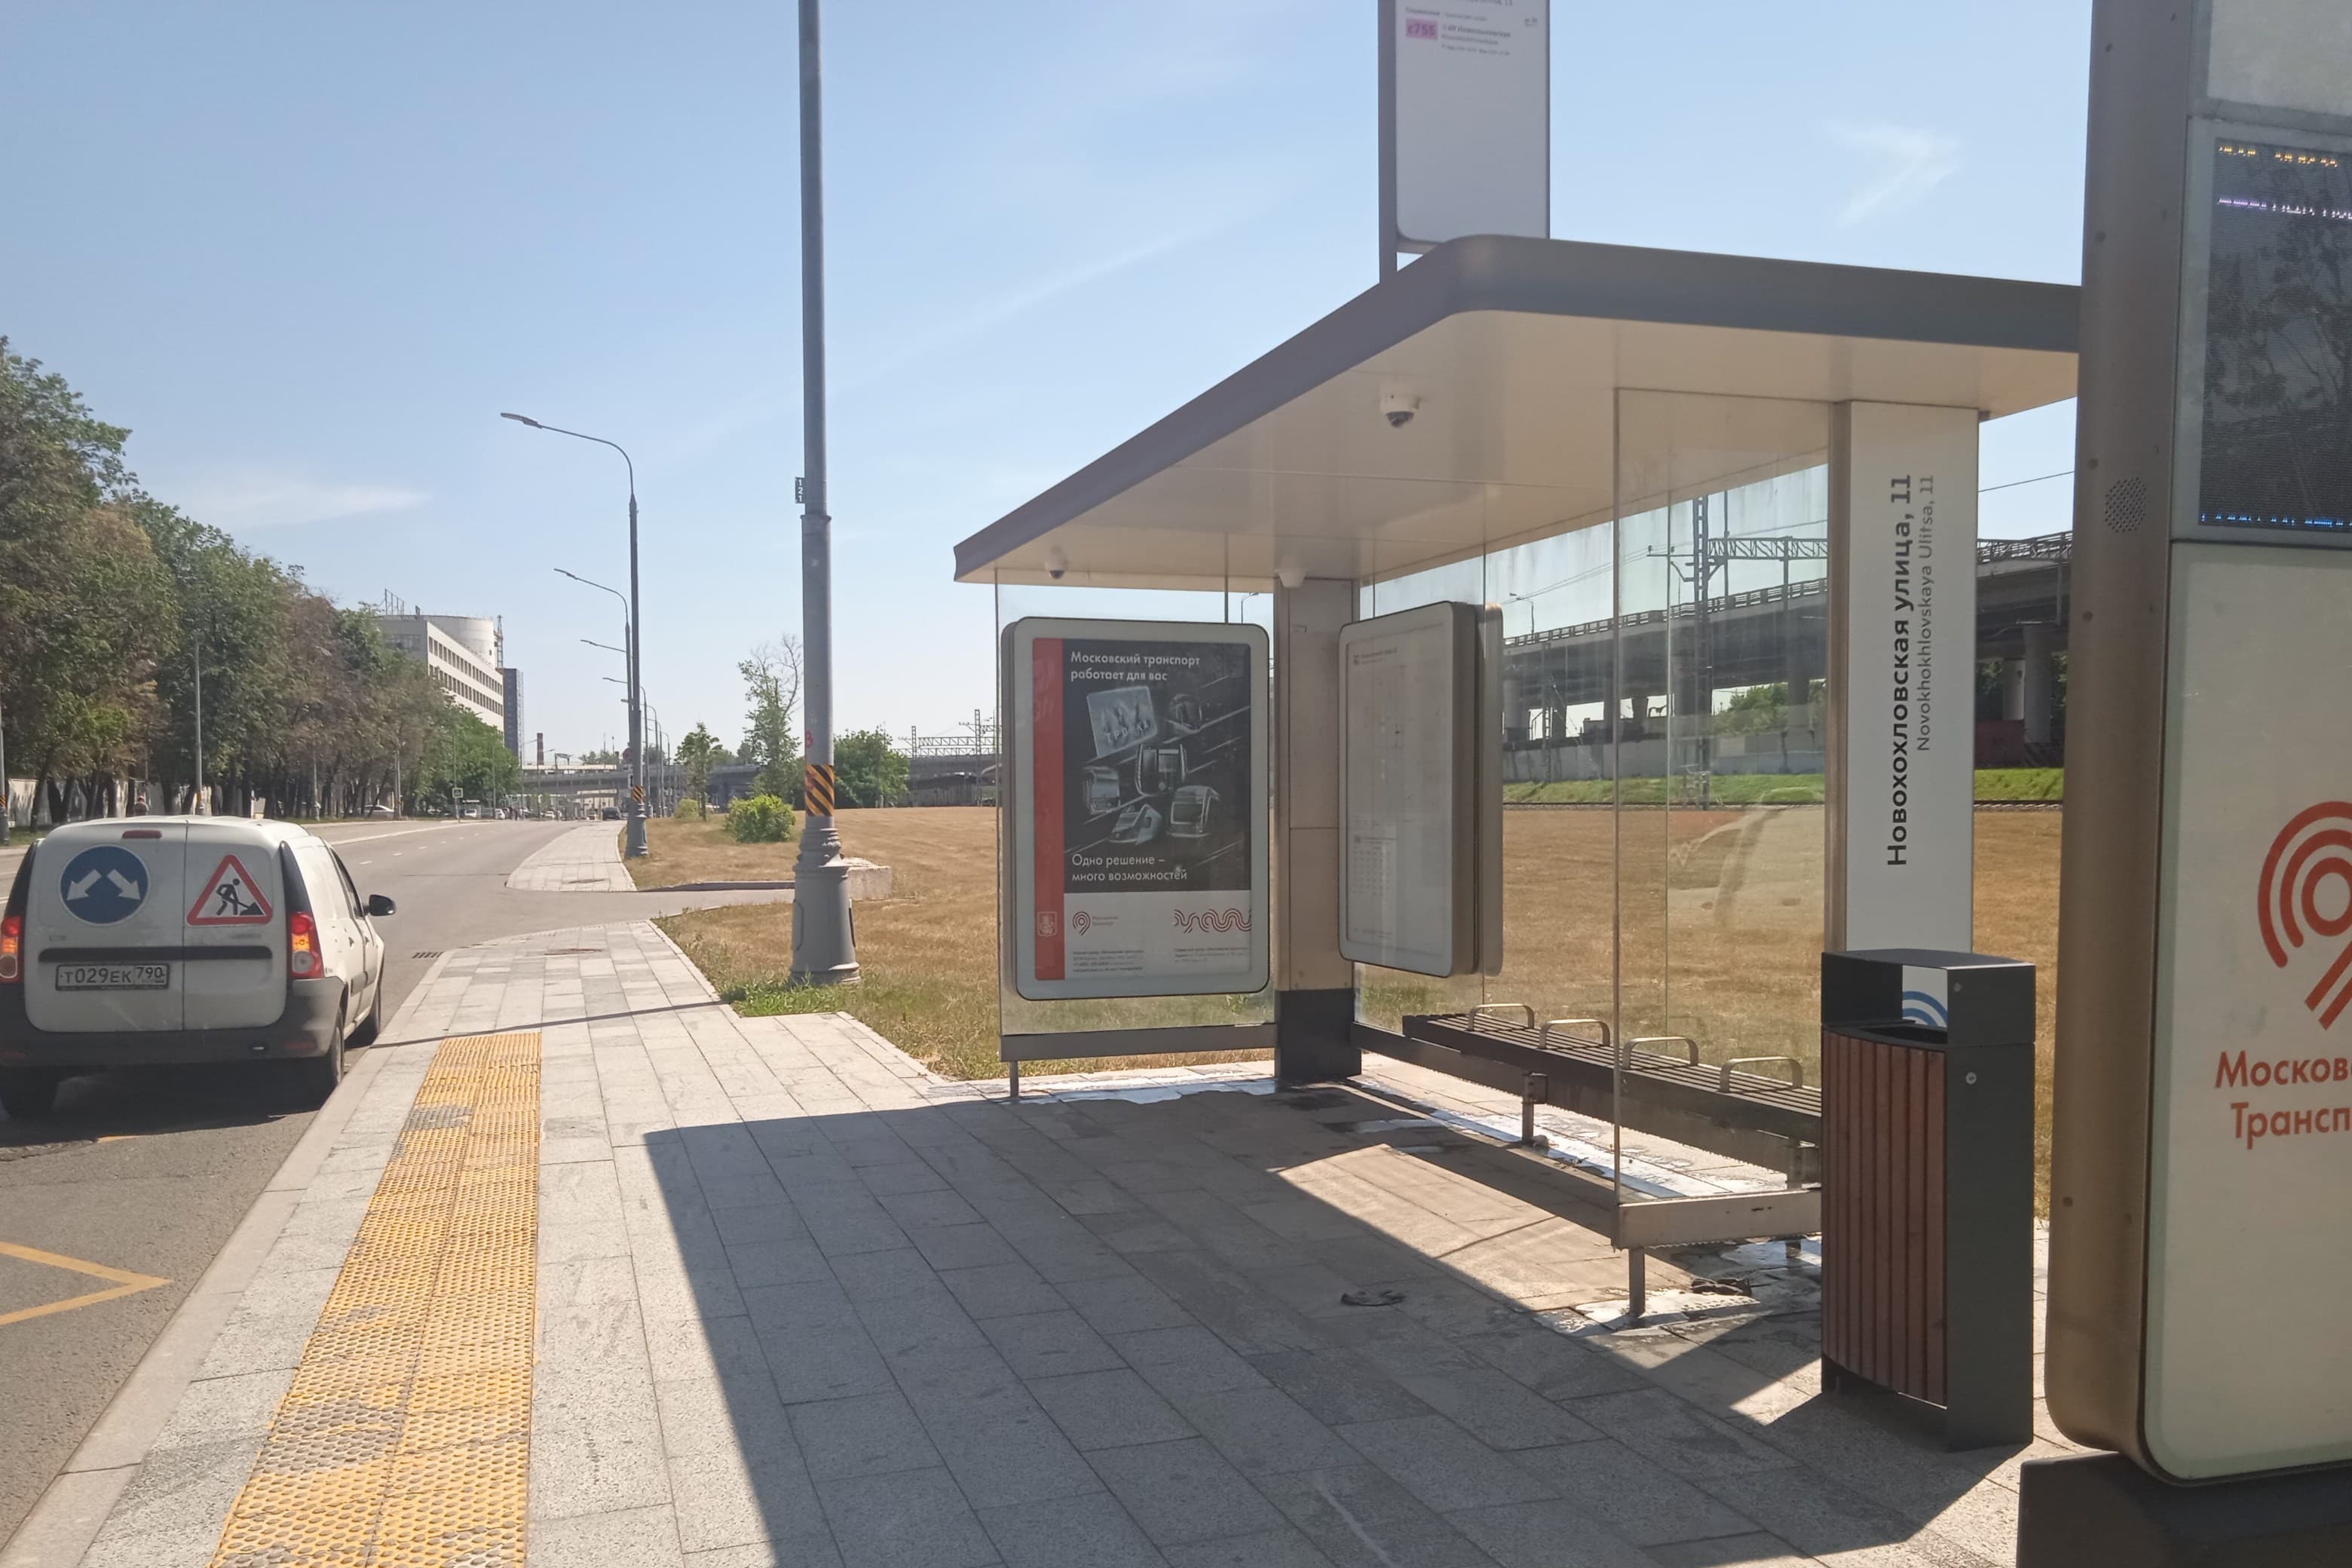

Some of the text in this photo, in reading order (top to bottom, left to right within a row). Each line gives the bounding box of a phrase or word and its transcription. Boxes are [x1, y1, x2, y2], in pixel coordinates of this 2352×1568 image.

[1917, 476, 1935, 751] Novokhokhlovskaya Ulitsa, 11
[1070, 651, 1200, 669] Московский транспорт
[1070, 667, 1168, 681] работает для вас
[1887, 475, 1914, 865] Новохохловская улица, 11
[1072, 853, 1103, 867] Одно
[1106, 856, 1155, 868] решение
[1071, 868, 1187, 881] много возможностей
[136, 966, 163, 978] 790
[2215, 1050, 2352, 1089] Москов
[2231, 1102, 2350, 1150] Трансп
